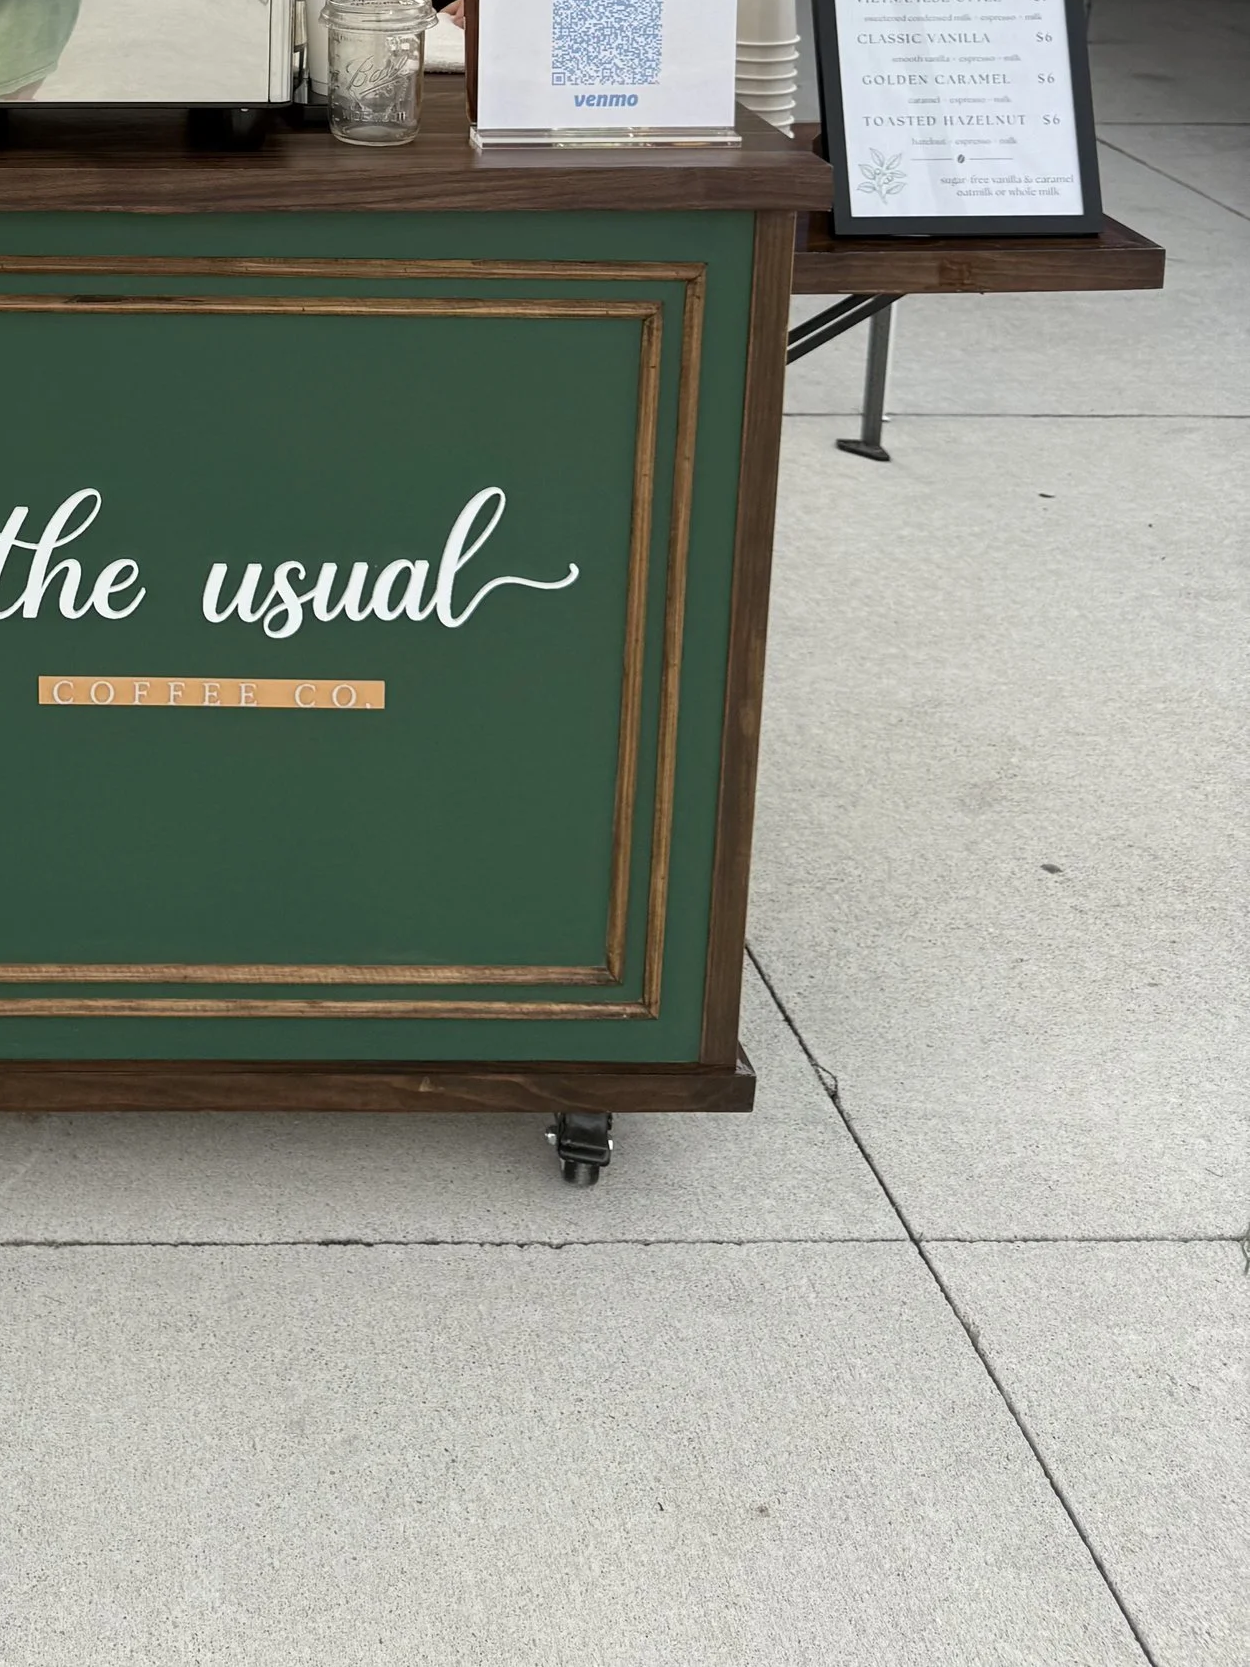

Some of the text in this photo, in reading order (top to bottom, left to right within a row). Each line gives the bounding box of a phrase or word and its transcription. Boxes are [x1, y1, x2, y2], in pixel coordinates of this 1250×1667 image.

[857, 33, 922, 45] CLASSIC
[927, 33, 991, 45] VANILLA
[862, 74, 928, 86] GOLDEN
[934, 73, 1011, 85] CARAMEL
[574, 94, 639, 107] venmo
[863, 115, 936, 127] TOASTED
[944, 114, 1027, 126] HAZELNUT
[202, 486, 580, 639] usual
[52, 680, 371, 709] COFFEE CO.
